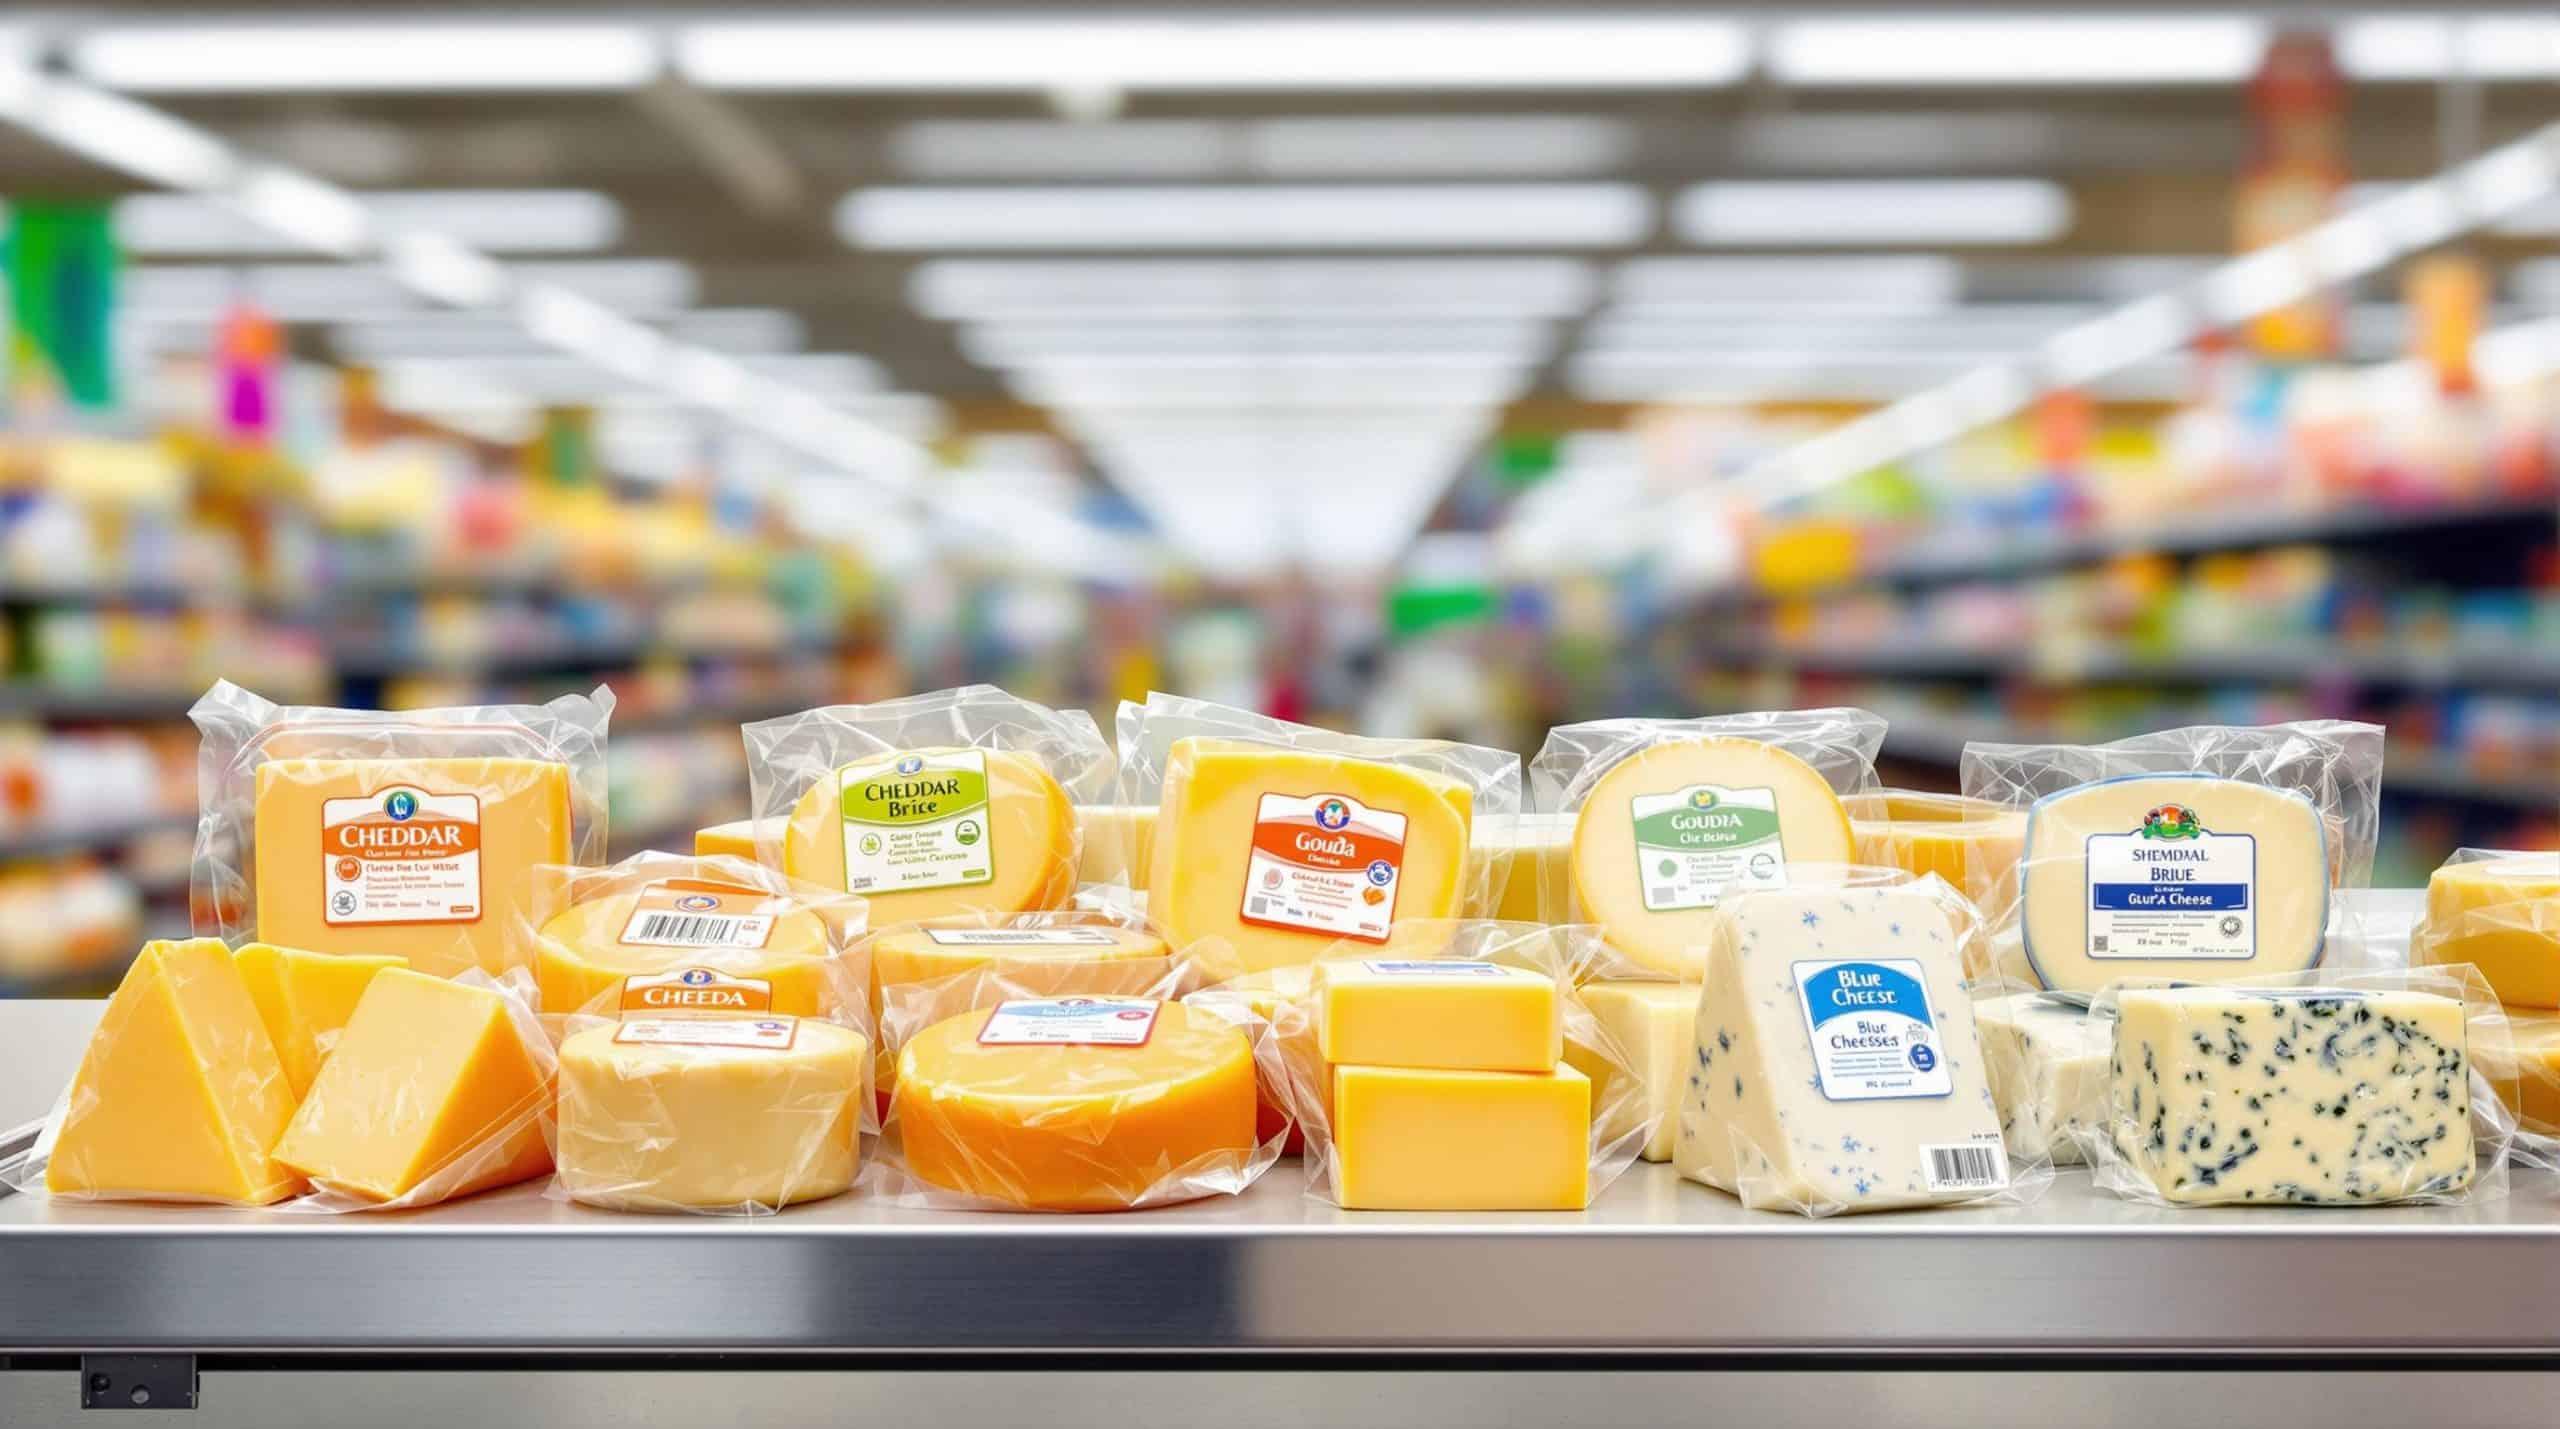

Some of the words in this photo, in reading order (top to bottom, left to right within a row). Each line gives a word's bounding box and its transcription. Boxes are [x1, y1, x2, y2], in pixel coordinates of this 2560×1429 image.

[865, 779, 960, 801] CHEDDAR
[889, 800, 937, 817] Brice
[339, 825, 463, 848] CHEDDAR
[1295, 831, 1356, 858] Gouda
[2150, 867, 2195, 881] BRIUE
[2169, 893, 2213, 905] Cheese
[643, 988, 747, 1006] CHEEDA
[1857, 1021, 1888, 1034] Blue
